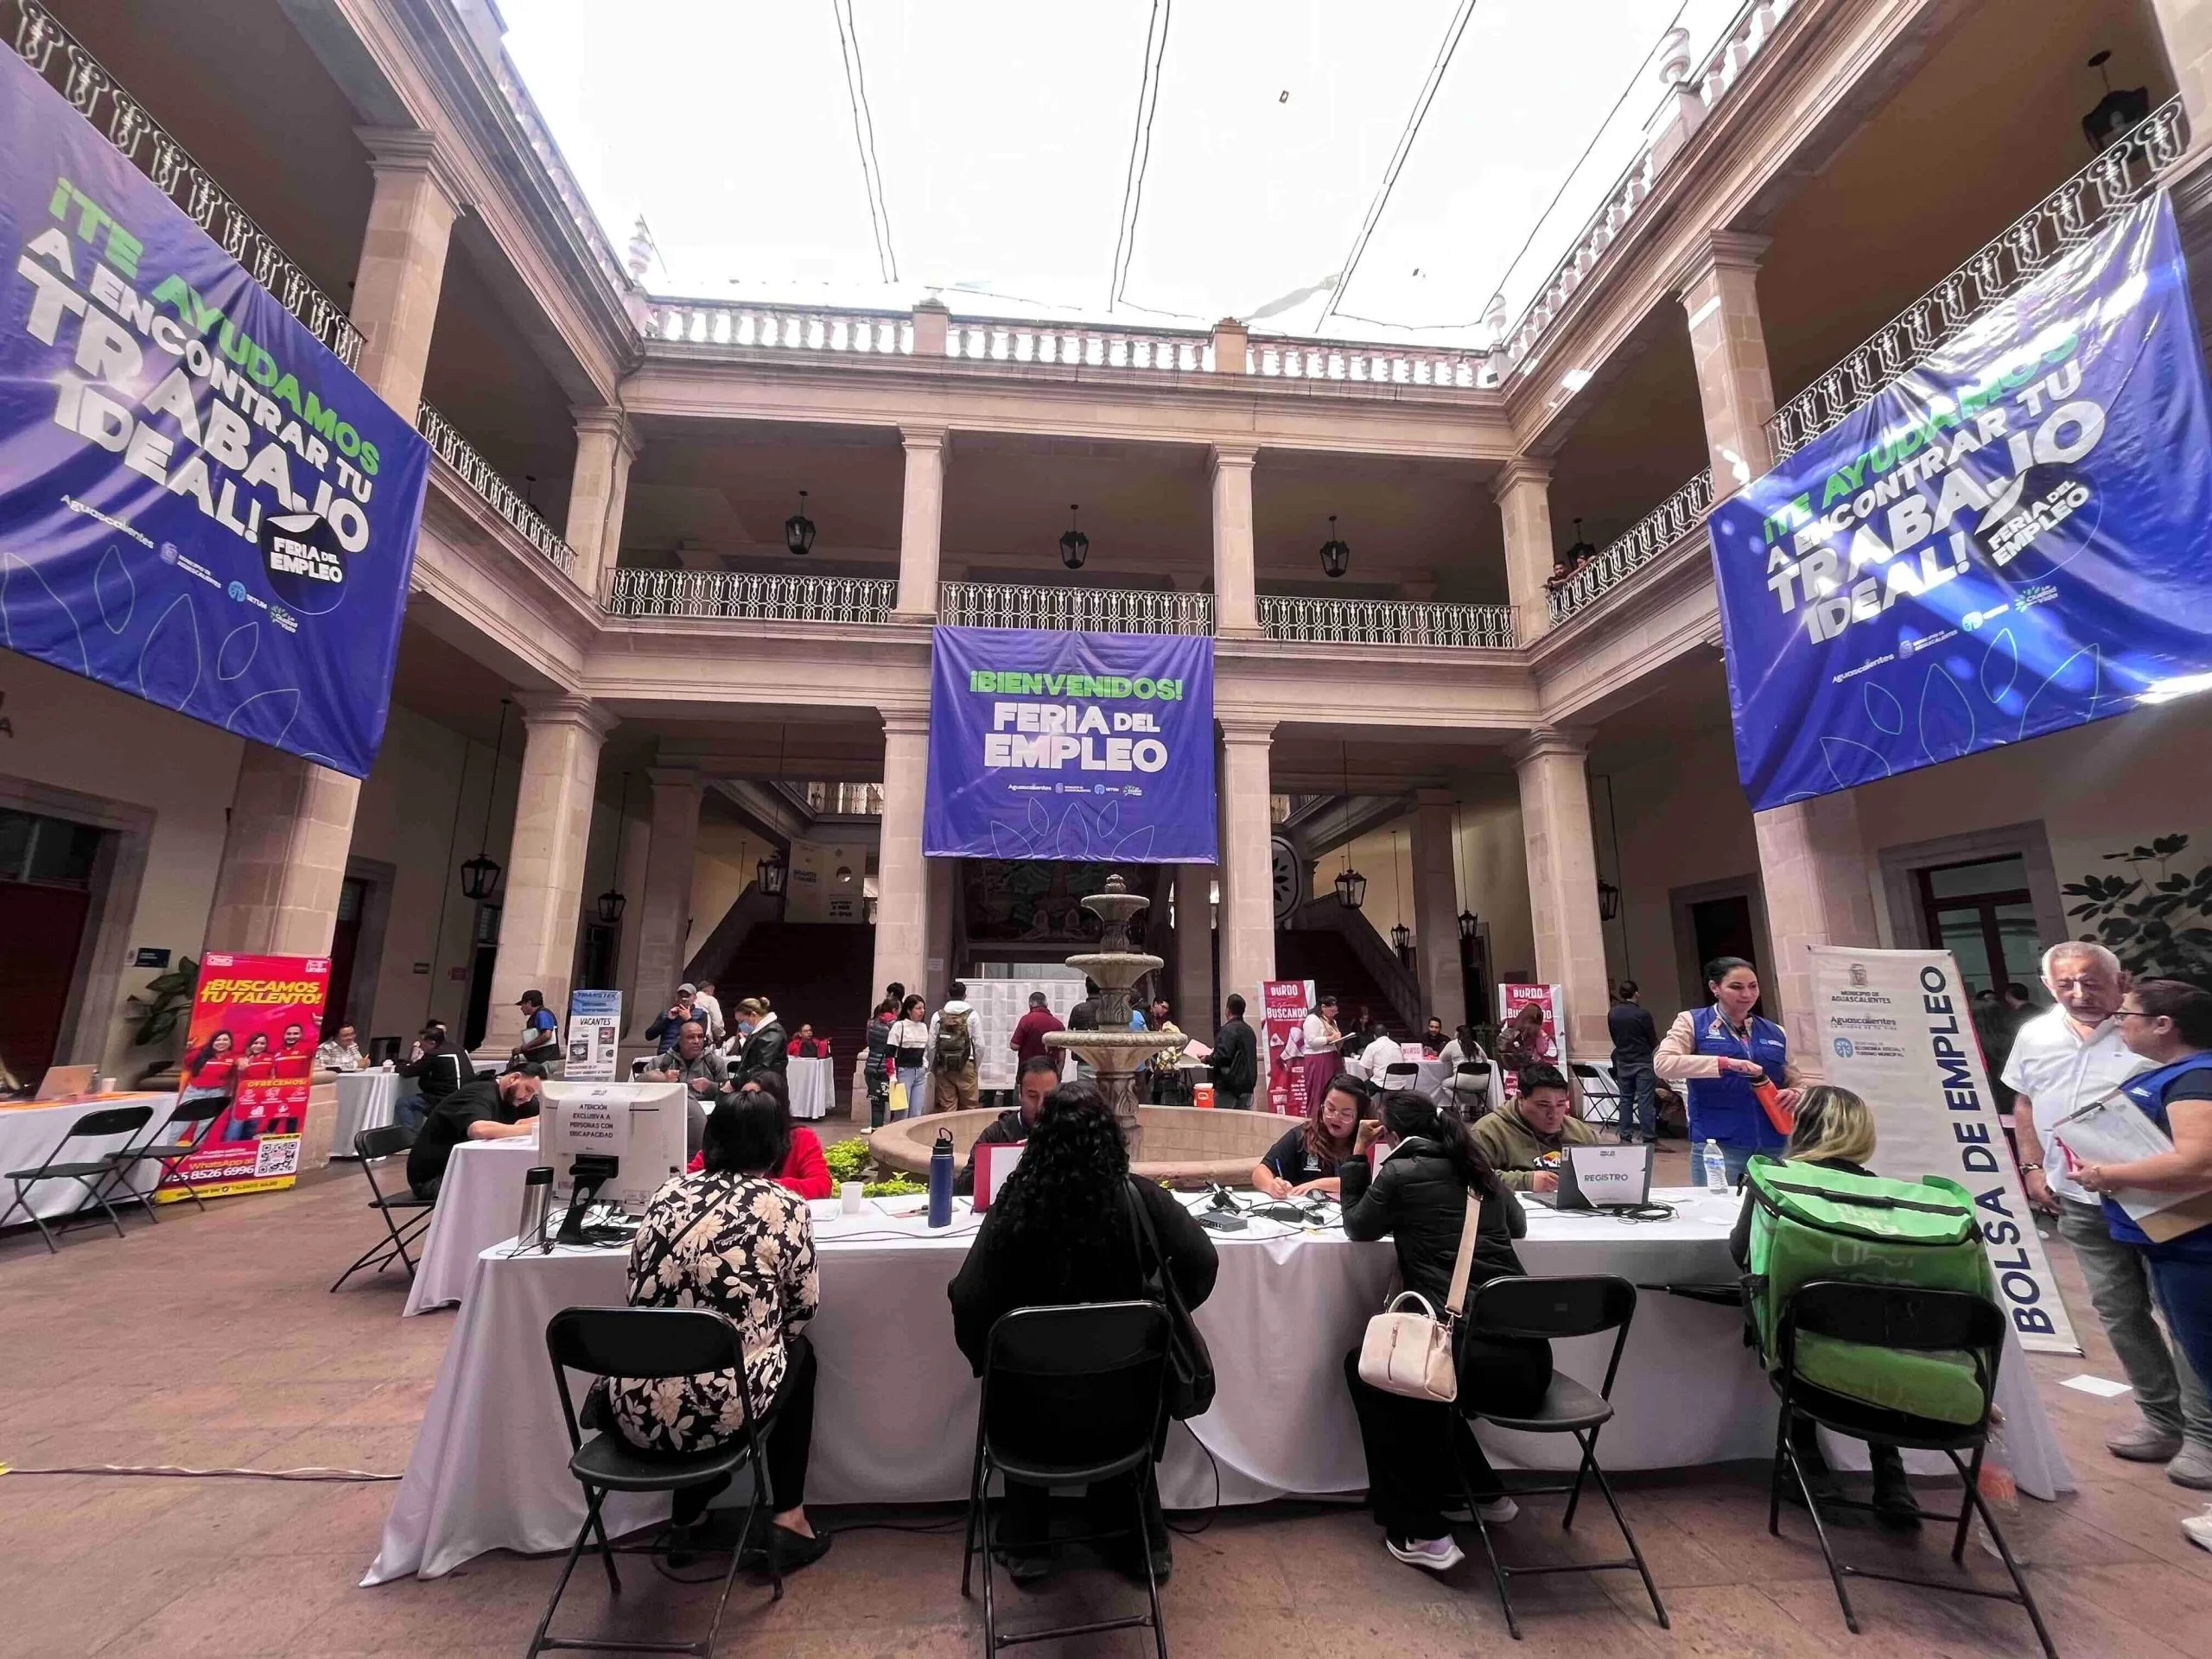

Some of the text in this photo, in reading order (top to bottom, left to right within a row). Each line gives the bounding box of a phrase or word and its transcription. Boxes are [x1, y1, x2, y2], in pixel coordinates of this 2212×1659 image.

[49, 176, 380, 476] ¡TE AYUDAMOS
[29, 227, 373, 505] A ENCONTRAR TU
[17, 254, 370, 553] TRABAJO
[1764, 334, 2079, 545] ¡TE AYUDAMOS
[50, 372, 262, 543] IDEAL!
[1767, 360, 2082, 575] A ENCONTRAR TU
[60, 494, 155, 549] Aguascalientes
[1767, 400, 2106, 614] TRABAJO
[1987, 479, 2077, 550] FERIA DEL
[1991, 486, 2093, 568] EMPLEO
[273, 536, 340, 565] FERIA DEL
[270, 551, 343, 583] EMPLEO
[1802, 531, 1971, 646] IDEAL!
[1832, 653, 1895, 684] Aguascalientes
[969, 670, 1183, 702] ¡BIENVENIDOS!
[994, 702, 1160, 734] FERIA DEL
[984, 733, 1167, 772] EMPLEO
[200, 990, 323, 1005] TU TALENTO!
[204, 978, 320, 993] ¡BUSCAMOS
[1270, 984, 1299, 996] BURDO
[1513, 988, 1544, 999] BURDO
[1831, 995, 1891, 1004] AGUASCALIENTES
[1266, 1007, 1308, 1019] BUSCANDO
[1830, 1015, 1897, 1026] Aguascalientes
[189, 1160, 244, 1170] WhatsApp
[1919, 965, 2056, 1336] BOLSA DE EMPLEO
[191, 1167, 222, 1180] 8526
[224, 1165, 255, 1177] 6996
[1584, 1173, 1629, 1182] REGISTRO
